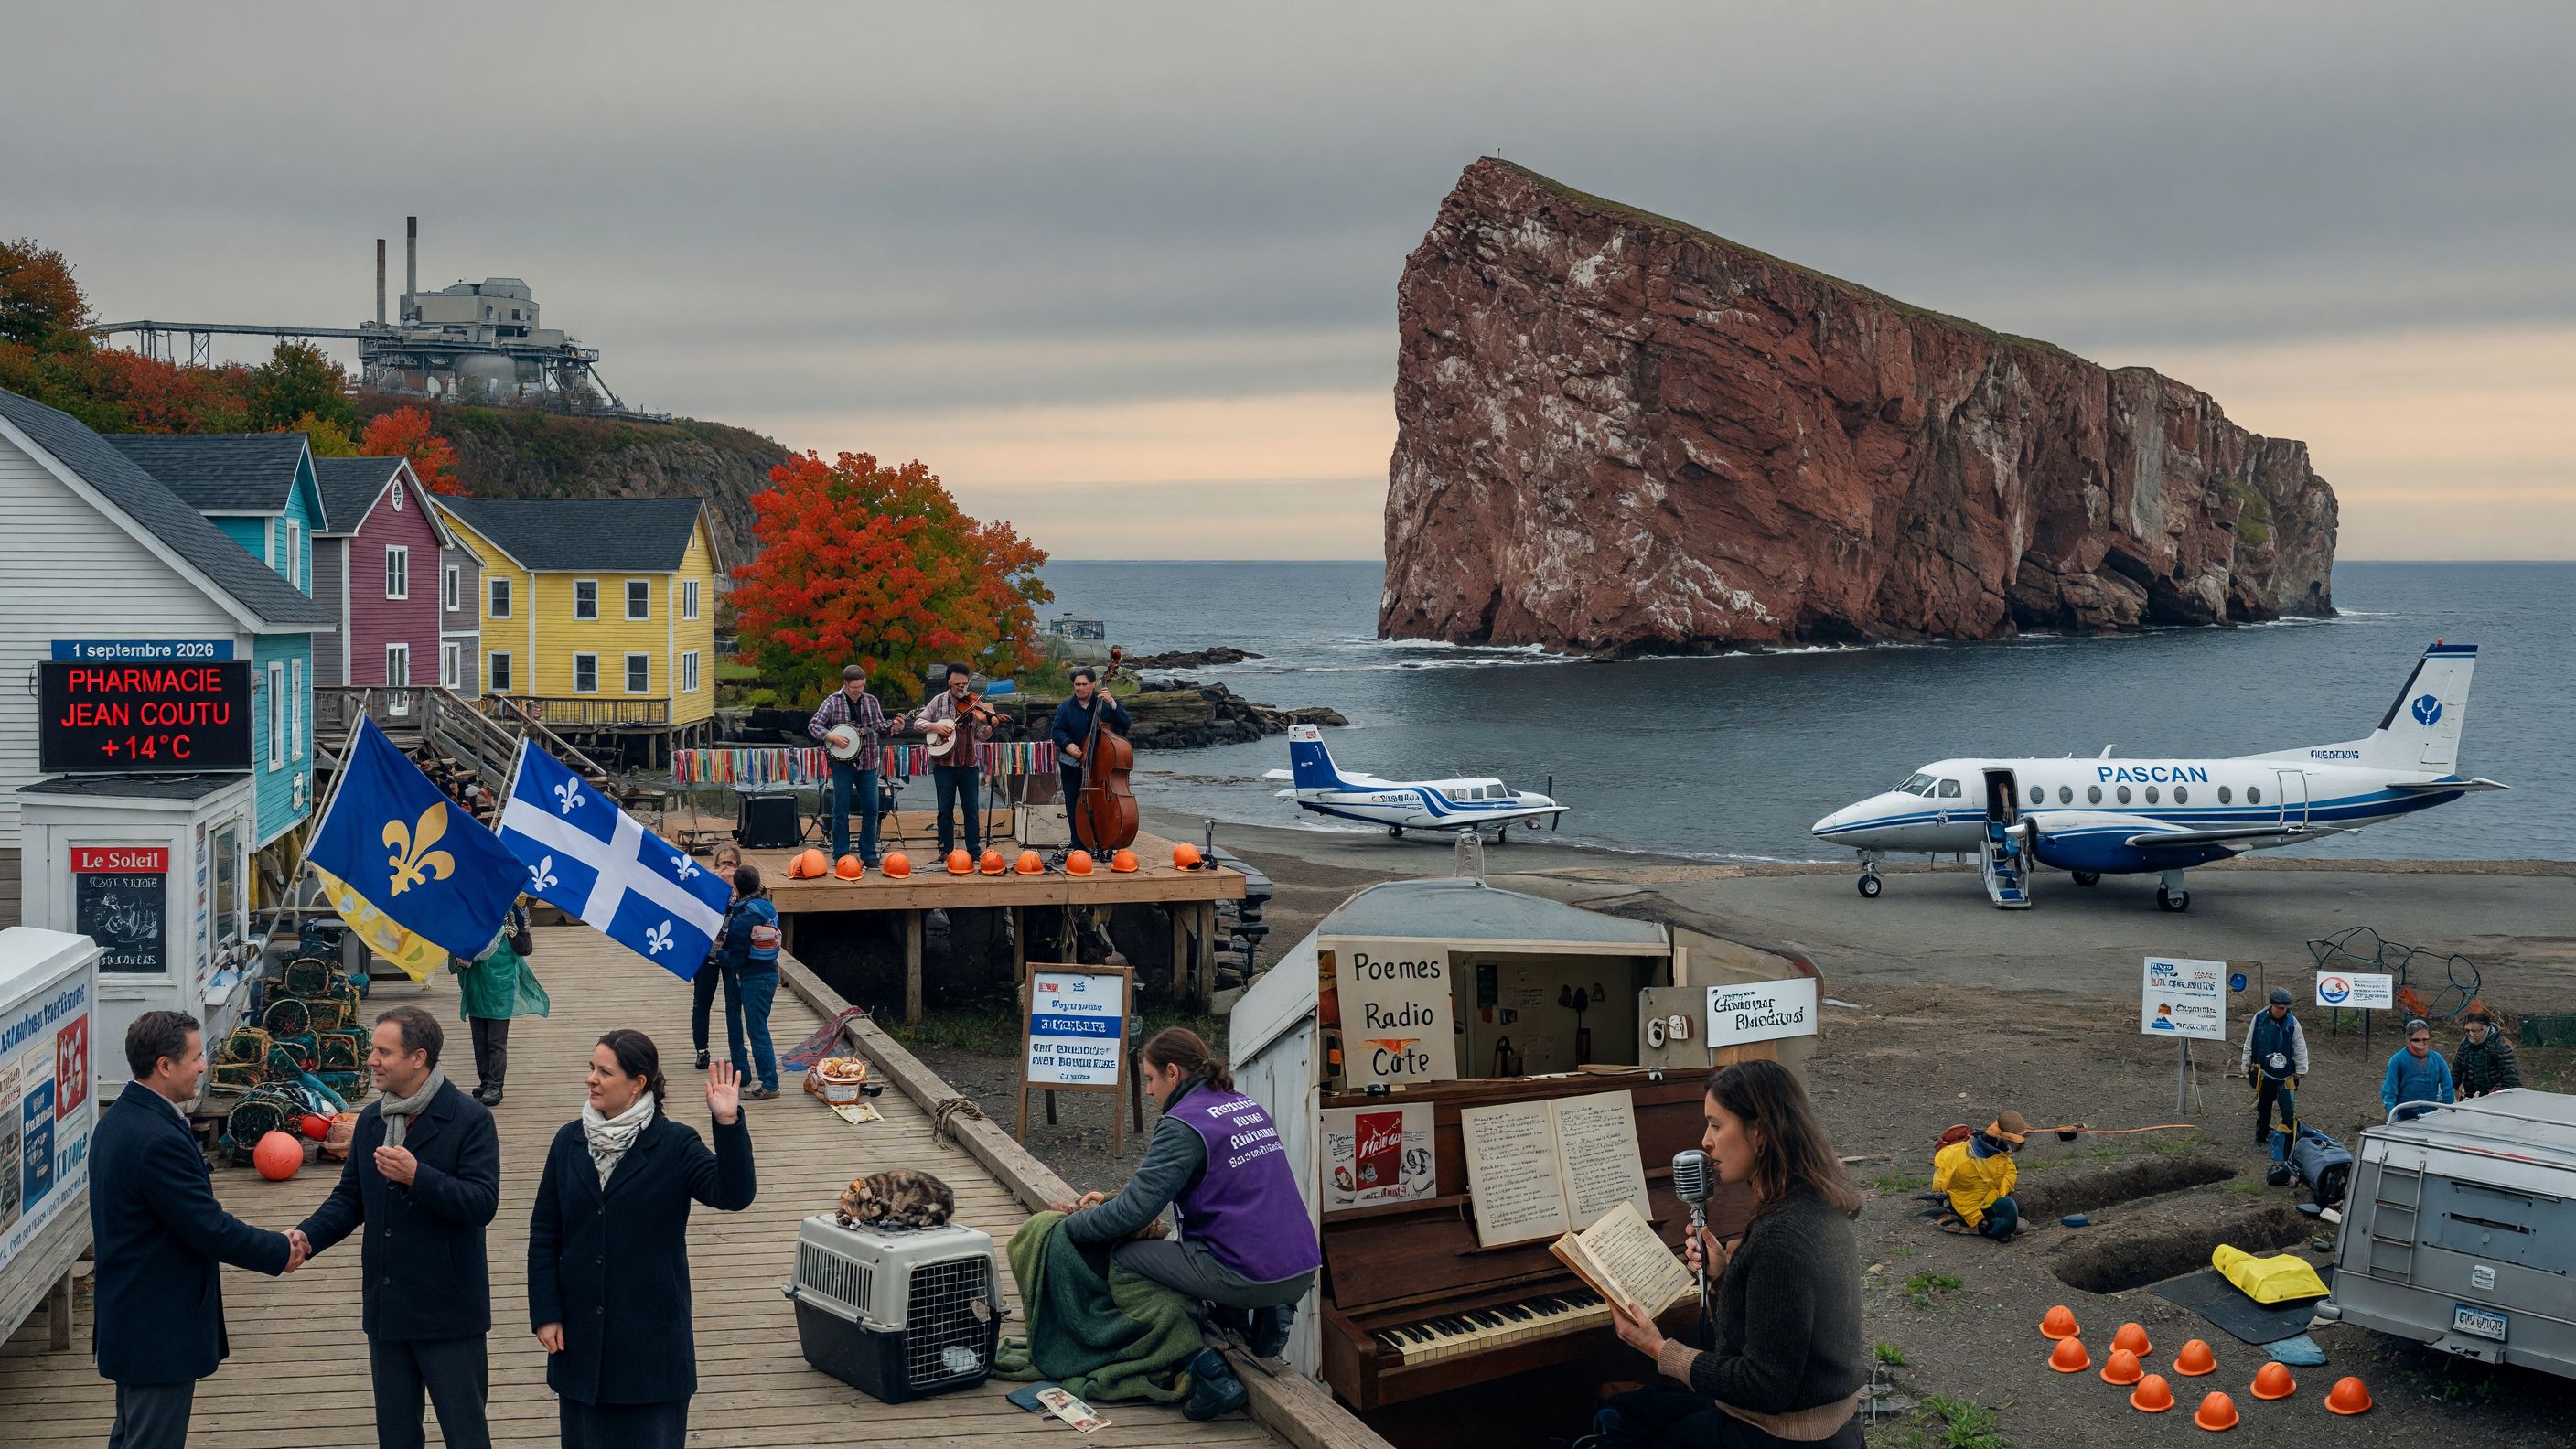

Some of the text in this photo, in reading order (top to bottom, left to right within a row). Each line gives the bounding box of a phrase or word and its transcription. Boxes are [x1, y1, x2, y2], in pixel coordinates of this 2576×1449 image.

[73, 643, 214, 660] 1 septembre 2026
[69, 669, 222, 692] PHARMACIE
[61, 702, 230, 727] JEAN COUTU
[102, 735, 191, 760] +14°C
[2097, 767, 2208, 783] PASCAN
[82, 852, 158, 868] Le Soleil
[1353, 952, 1441, 981] Poemes
[1364, 1001, 1433, 1030] Radio
